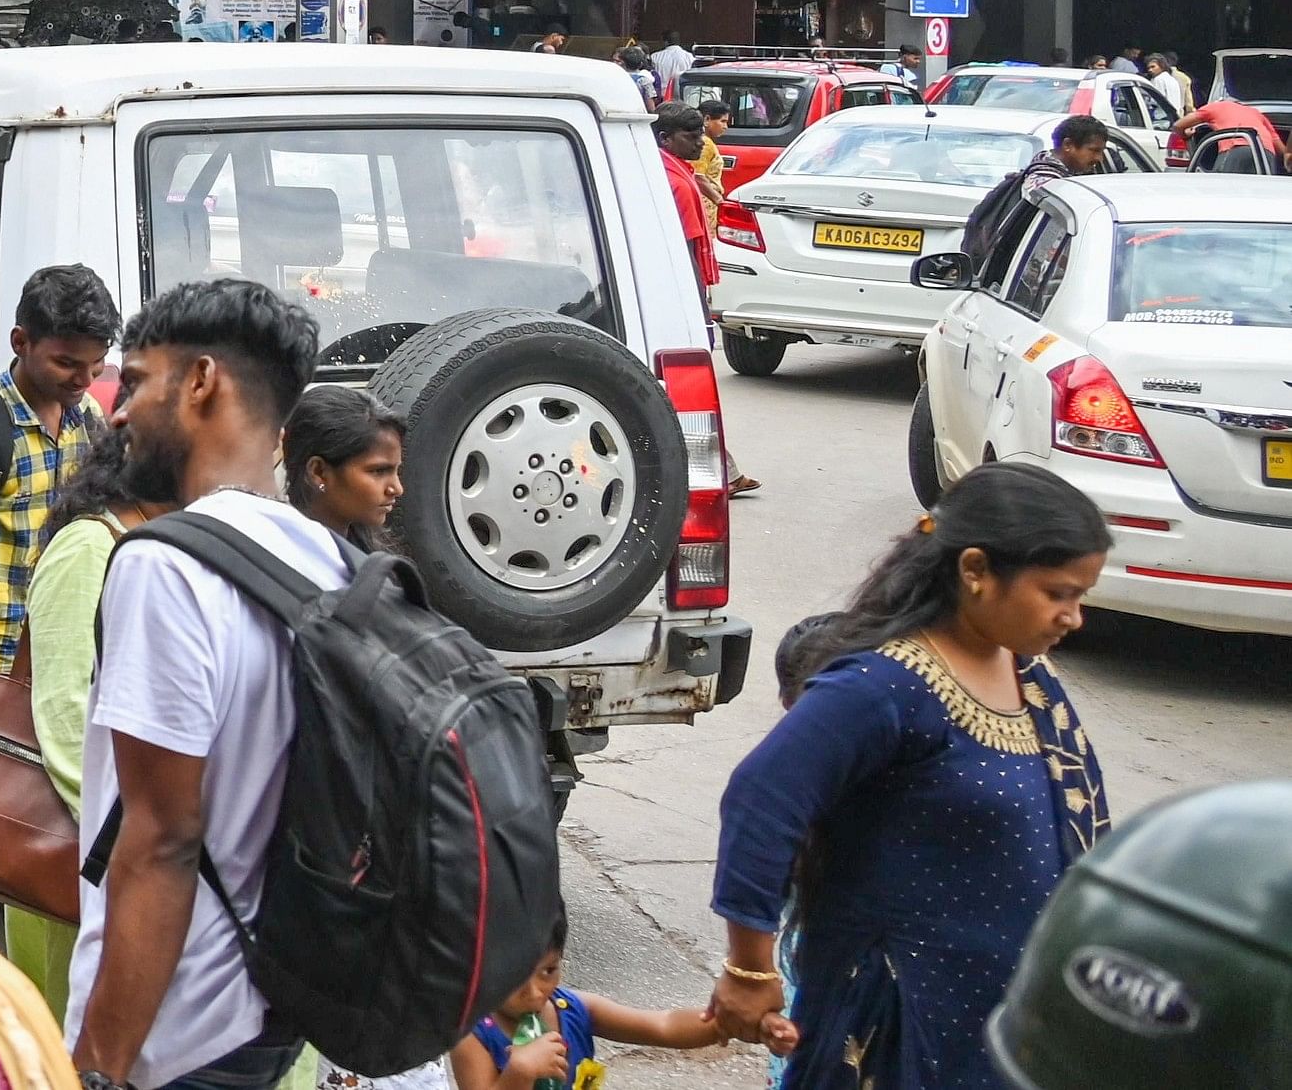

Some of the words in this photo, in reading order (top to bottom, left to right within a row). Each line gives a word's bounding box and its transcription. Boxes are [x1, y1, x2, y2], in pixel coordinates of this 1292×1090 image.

[932, 23, 942, 47] 3
[825, 228, 919, 248] KA06AC3494
[1123, 312, 1156, 323] MOB:
[1143, 377, 1200, 386] MARUTI
